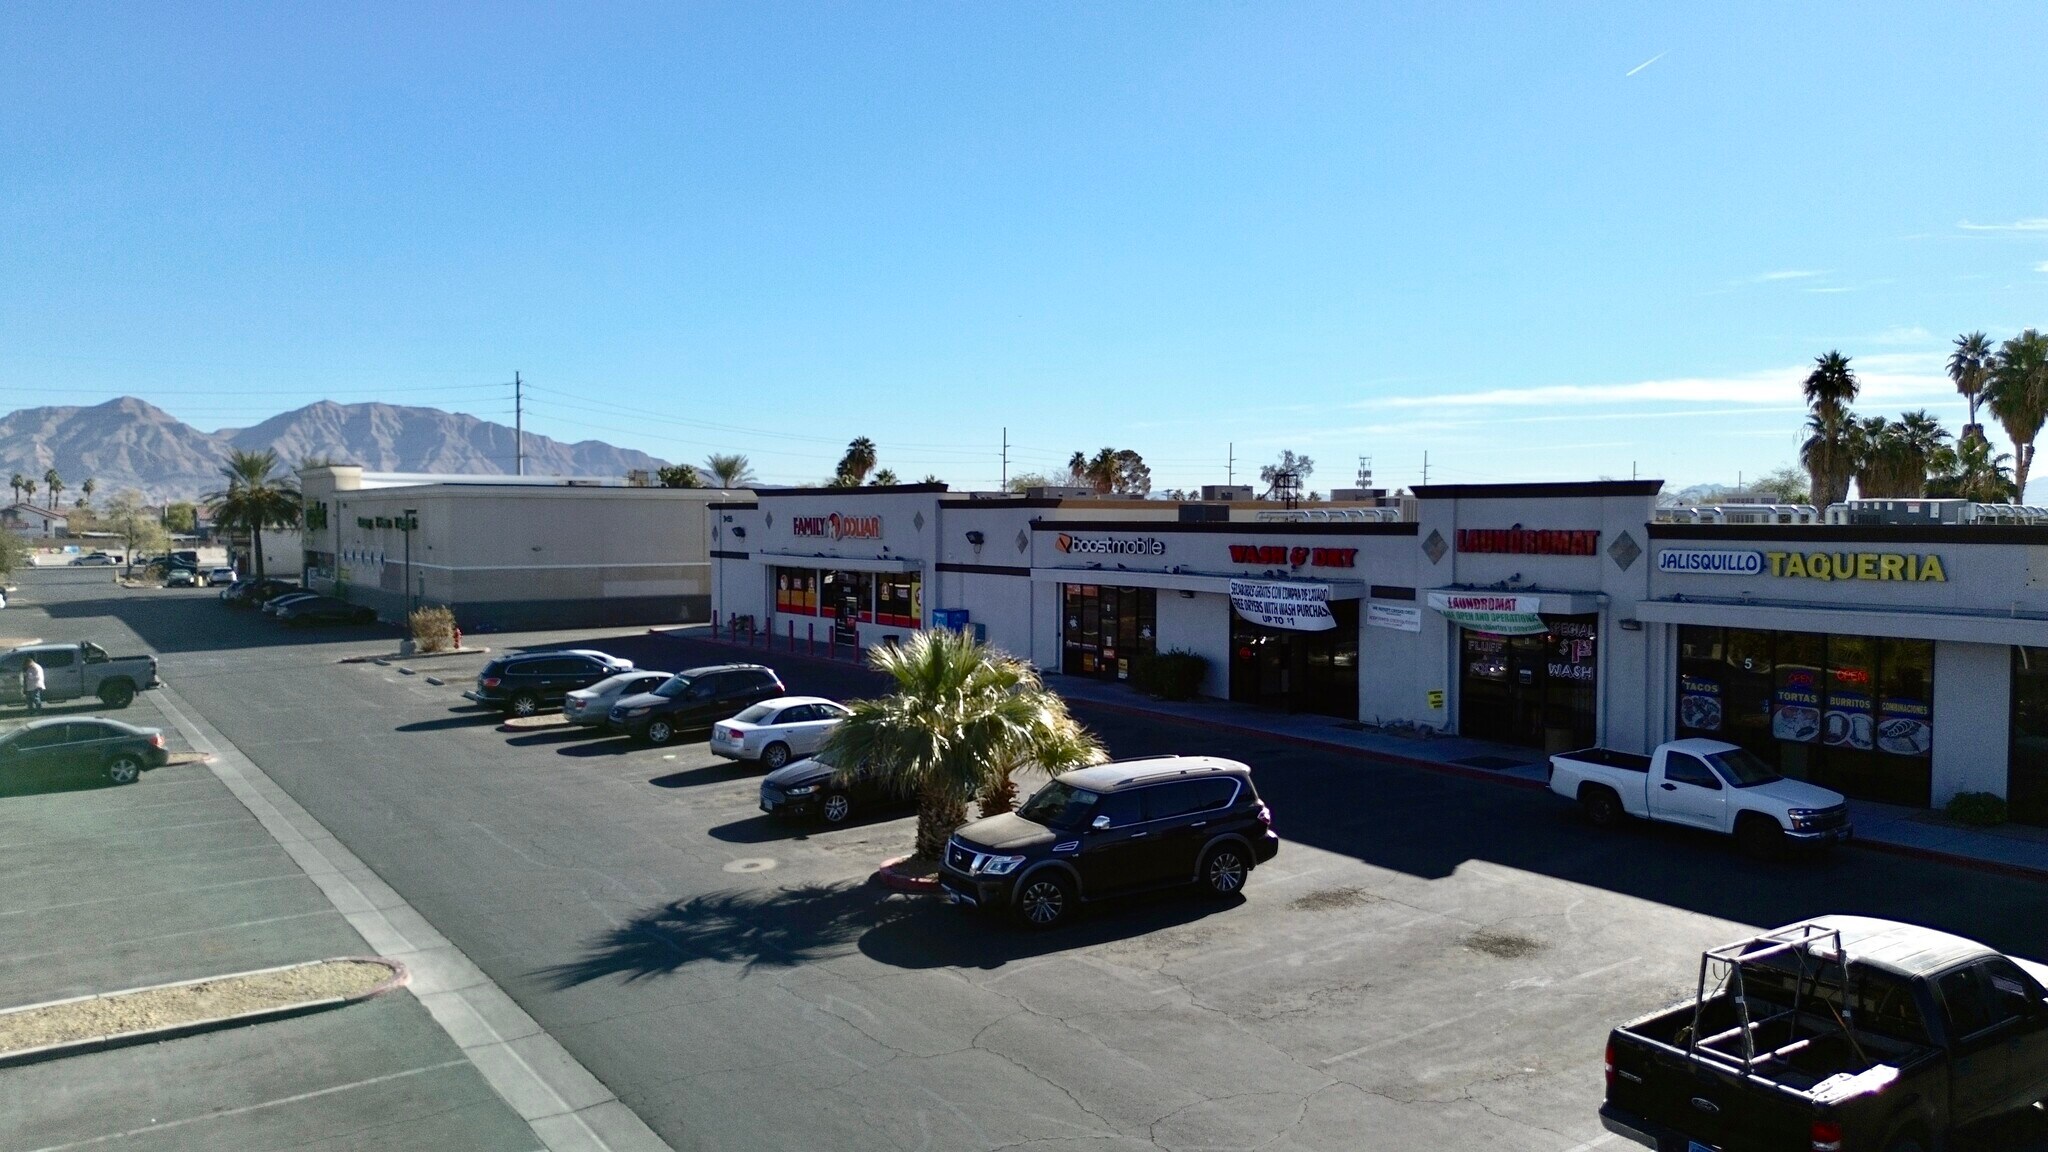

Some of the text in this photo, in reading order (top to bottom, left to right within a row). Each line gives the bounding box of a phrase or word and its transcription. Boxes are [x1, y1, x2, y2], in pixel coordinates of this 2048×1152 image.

[793, 516, 880, 538] FAMILY DOLLAR
[1456, 530, 1600, 556] LAUNDROMAT
[1229, 545, 1359, 567] WASH & DRY
[1660, 552, 1948, 582] JALISQUILLO TAQUERIA
[1264, 601, 1279, 615] WITH
[1279, 602, 1297, 616] WASH
[1447, 596, 1517, 612] LAUNDROMAT
[1262, 615, 1295, 626] UP TO $1
[1456, 611, 1474, 621] OPEN
[1475, 612, 1489, 622] AND
[1549, 621, 1595, 637] SPECIAL
[1467, 640, 1503, 653] FLUFF
[1744, 658, 1753, 669] 5
[1548, 663, 1594, 680] WASH
[1837, 669, 1868, 683] OPEN
[1685, 681, 1719, 693] TACOS
[1778, 691, 1817, 704] TORTAS
[1829, 697, 1871, 709] BURRITOS
[1882, 702, 1928, 715] COMBINACIONES
